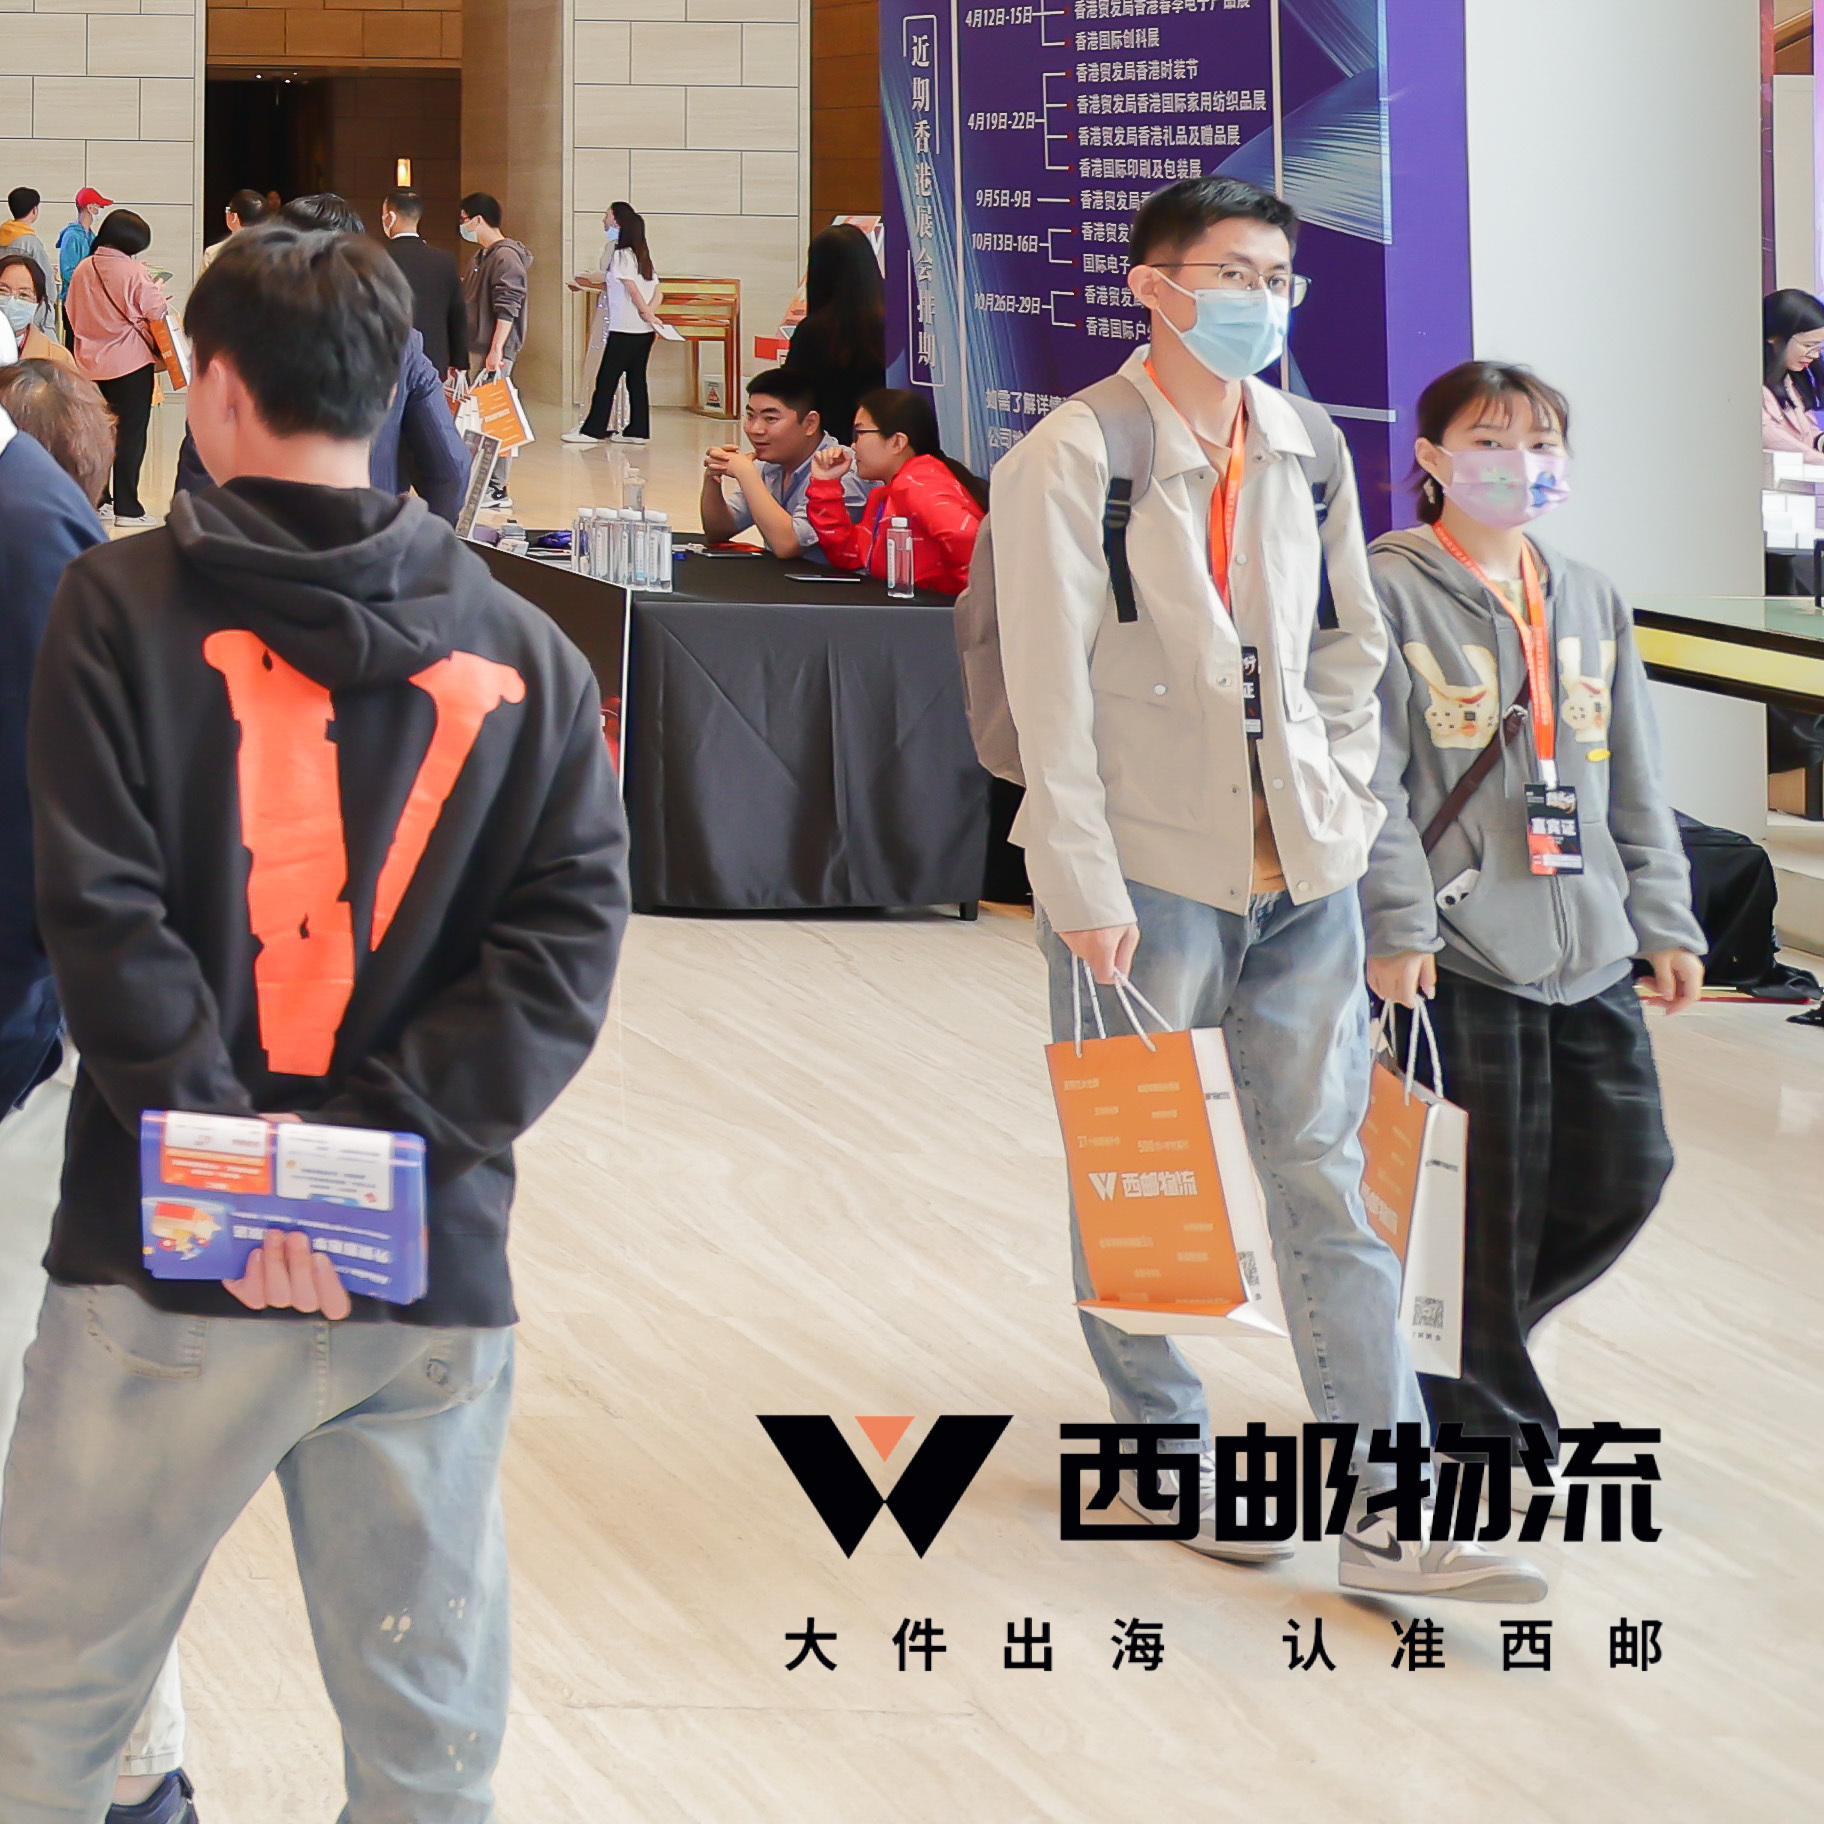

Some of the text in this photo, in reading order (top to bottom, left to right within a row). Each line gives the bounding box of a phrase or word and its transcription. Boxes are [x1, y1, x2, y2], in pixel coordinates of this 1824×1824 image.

[965, 5, 1033, 28] 4月12日-15日
[1074, 27, 1160, 52] 香港国际创科展
[1075, 58, 1199, 83] 香港贸发局香港时装节
[1076, 88, 1267, 115] 香港贸发局香港国际家用纺织品展
[967, 109, 1036, 132] 4月19日-22日
[1077, 124, 1241, 148] 香港贸发局香港礼品及赠品展
[1078, 157, 1202, 180] 香港国际印刷及包装展
[909, 31, 937, 370] 近期香港展会排期
[976, 189, 1032, 209] 9月5日-9日
[972, 233, 1039, 254] 10月13日-16日
[1081, 221, 1133, 244] 香港贸发
[974, 293, 1041, 315] 10月26日-29日
[1085, 316, 1151, 341] 香港国际户
[1121, 1171, 1198, 1198] 西邮物流
